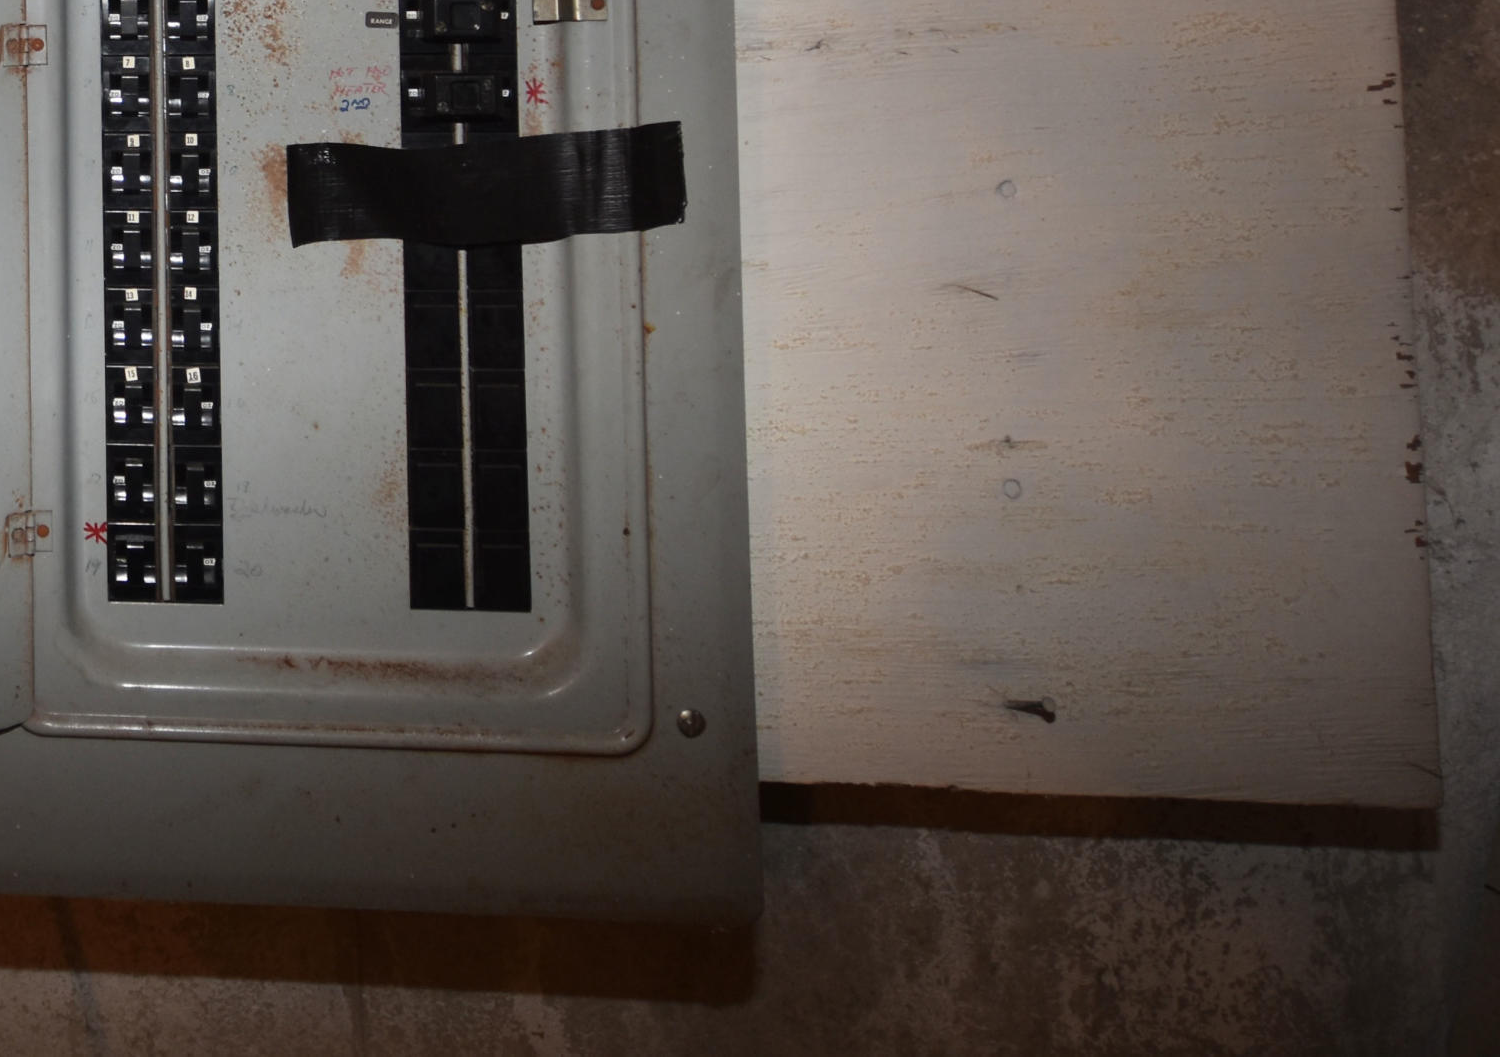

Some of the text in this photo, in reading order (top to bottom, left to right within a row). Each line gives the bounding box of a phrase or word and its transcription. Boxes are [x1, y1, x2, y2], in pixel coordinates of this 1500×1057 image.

[370, 17, 392, 25] RANGE
[187, 213, 195, 221] 12
[127, 369, 136, 378] 15
[188, 371, 199, 381] 16
